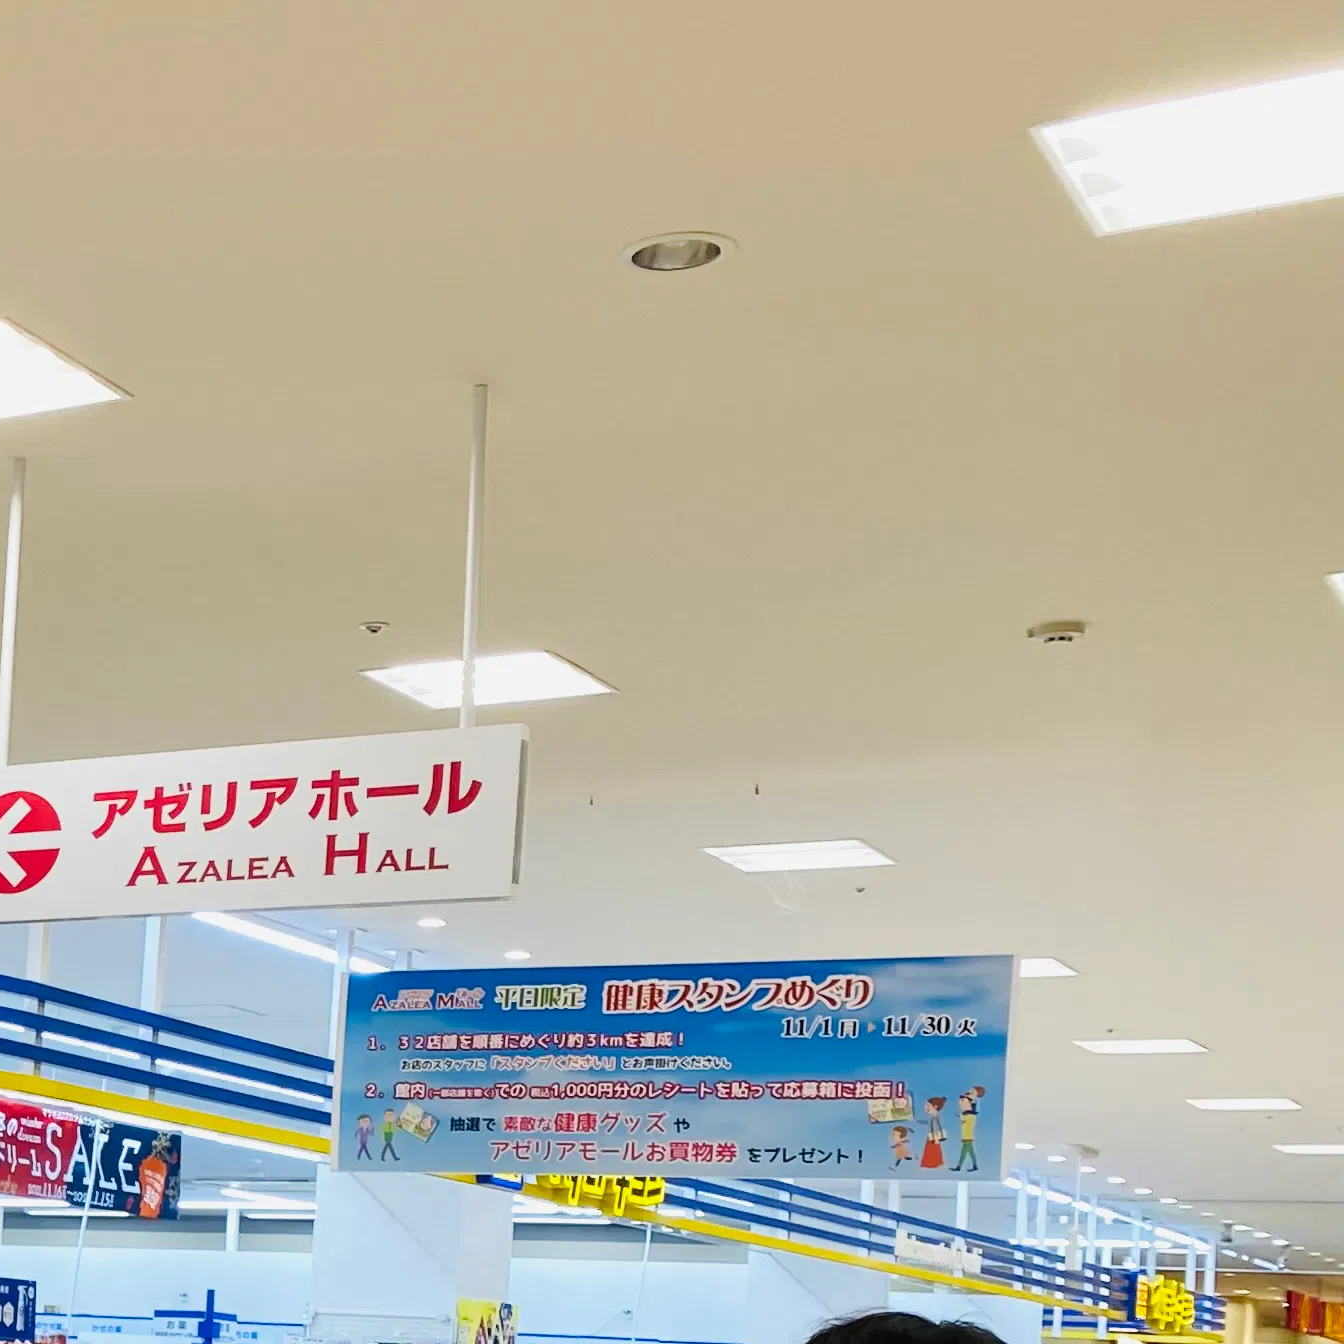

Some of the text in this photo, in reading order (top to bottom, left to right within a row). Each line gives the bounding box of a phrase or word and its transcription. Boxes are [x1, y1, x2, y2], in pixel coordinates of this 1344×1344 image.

[92, 761, 482, 839] アゼリアホール
[126, 832, 449, 887] AZALEA HALL
[373, 977, 873, 1013] AZALEA MALL 平日限定 健康スタンプめぐり
[783, 1017, 832, 1037] 11/1
[883, 1016, 950, 1036] 11/30
[44, 1122, 142, 1194] SALE
